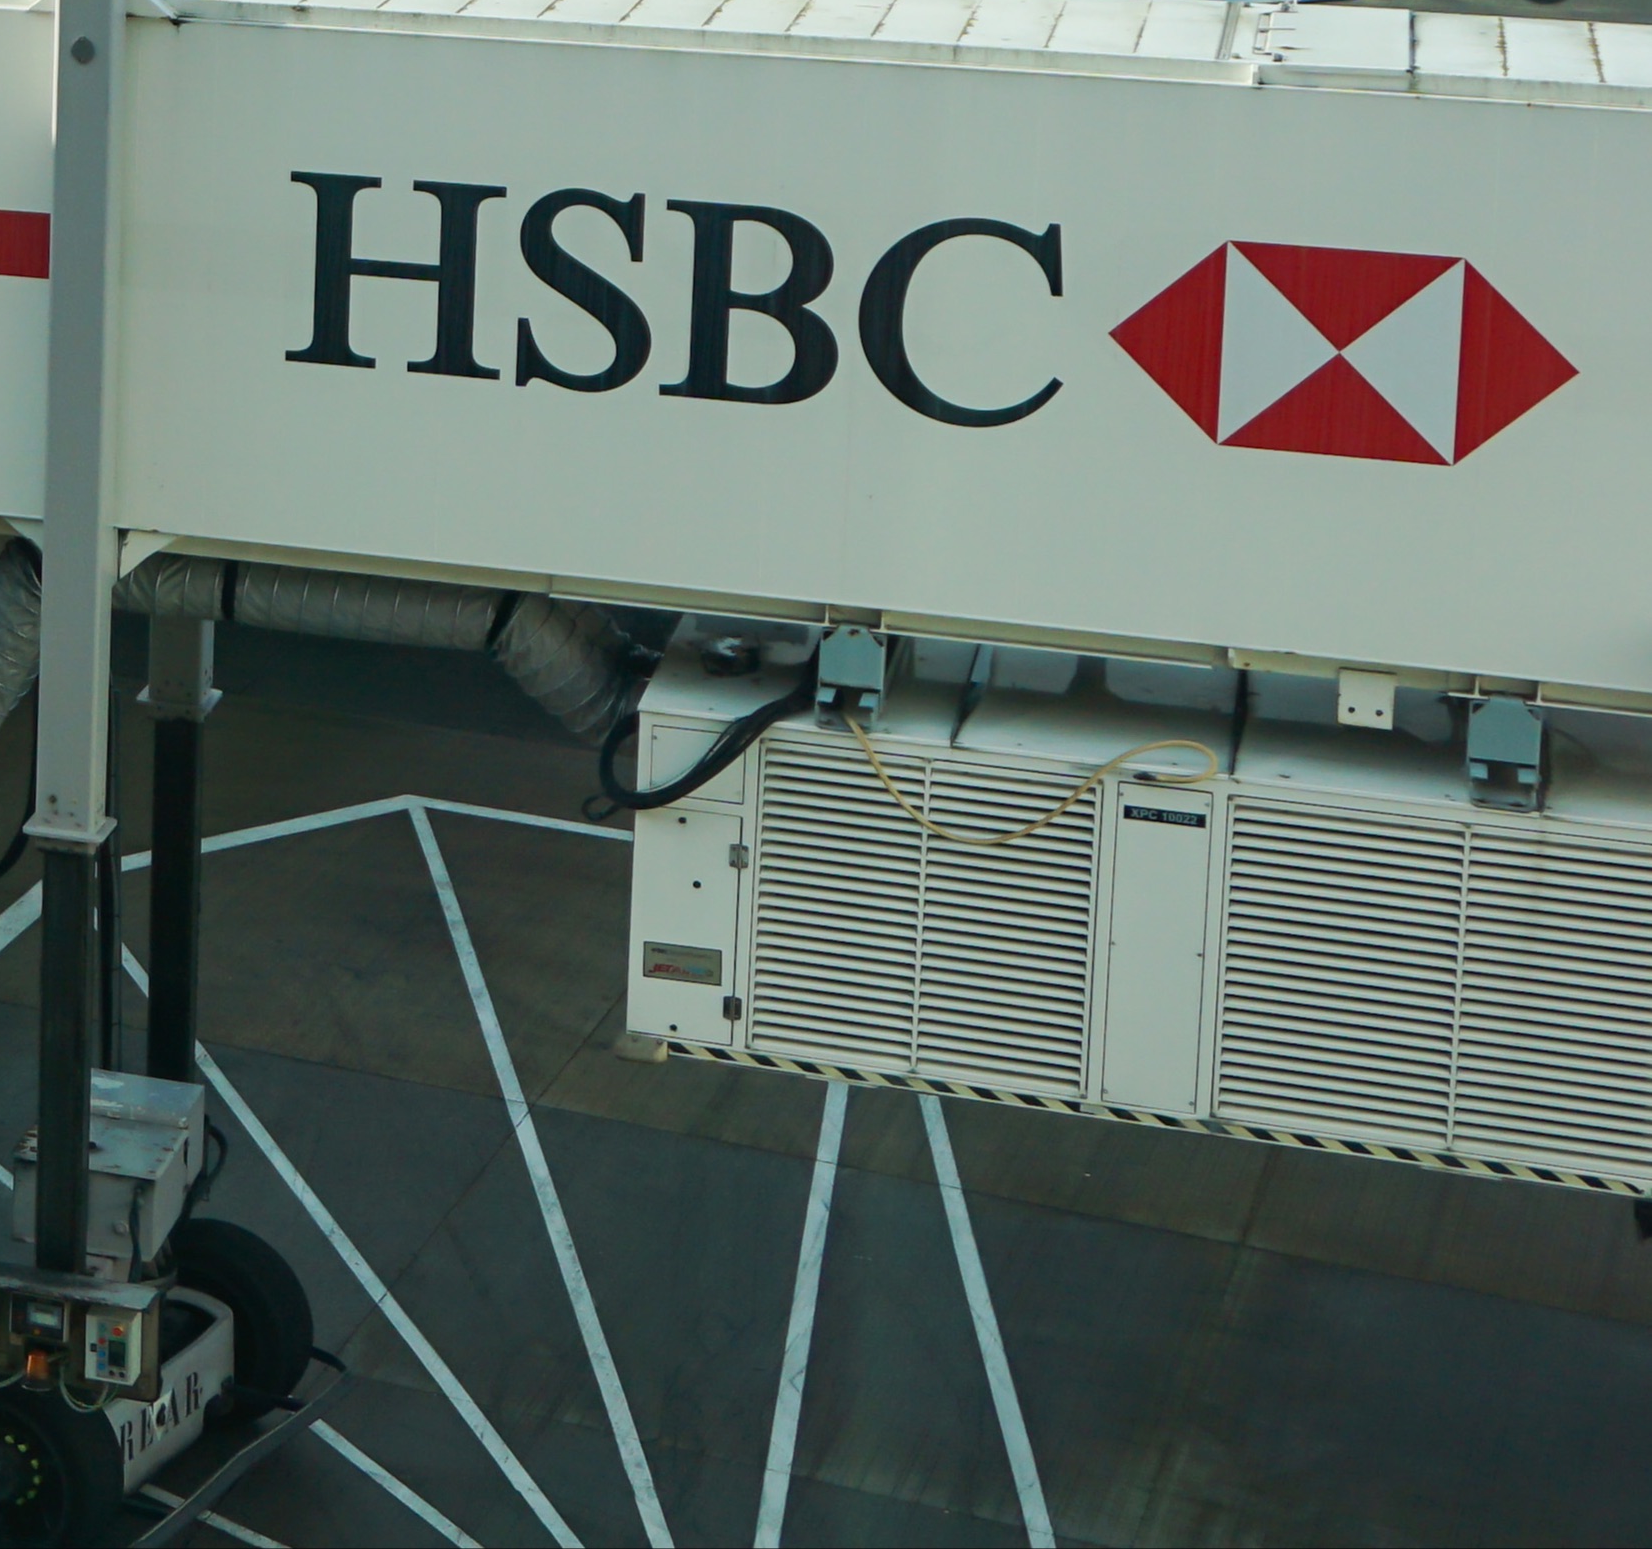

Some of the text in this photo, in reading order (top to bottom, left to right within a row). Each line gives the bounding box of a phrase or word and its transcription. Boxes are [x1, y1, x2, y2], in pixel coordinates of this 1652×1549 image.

[285, 170, 1064, 429] HSBC
[1130, 808, 1198, 825] XPC 10022
[120, 1371, 203, 1461] REAR
